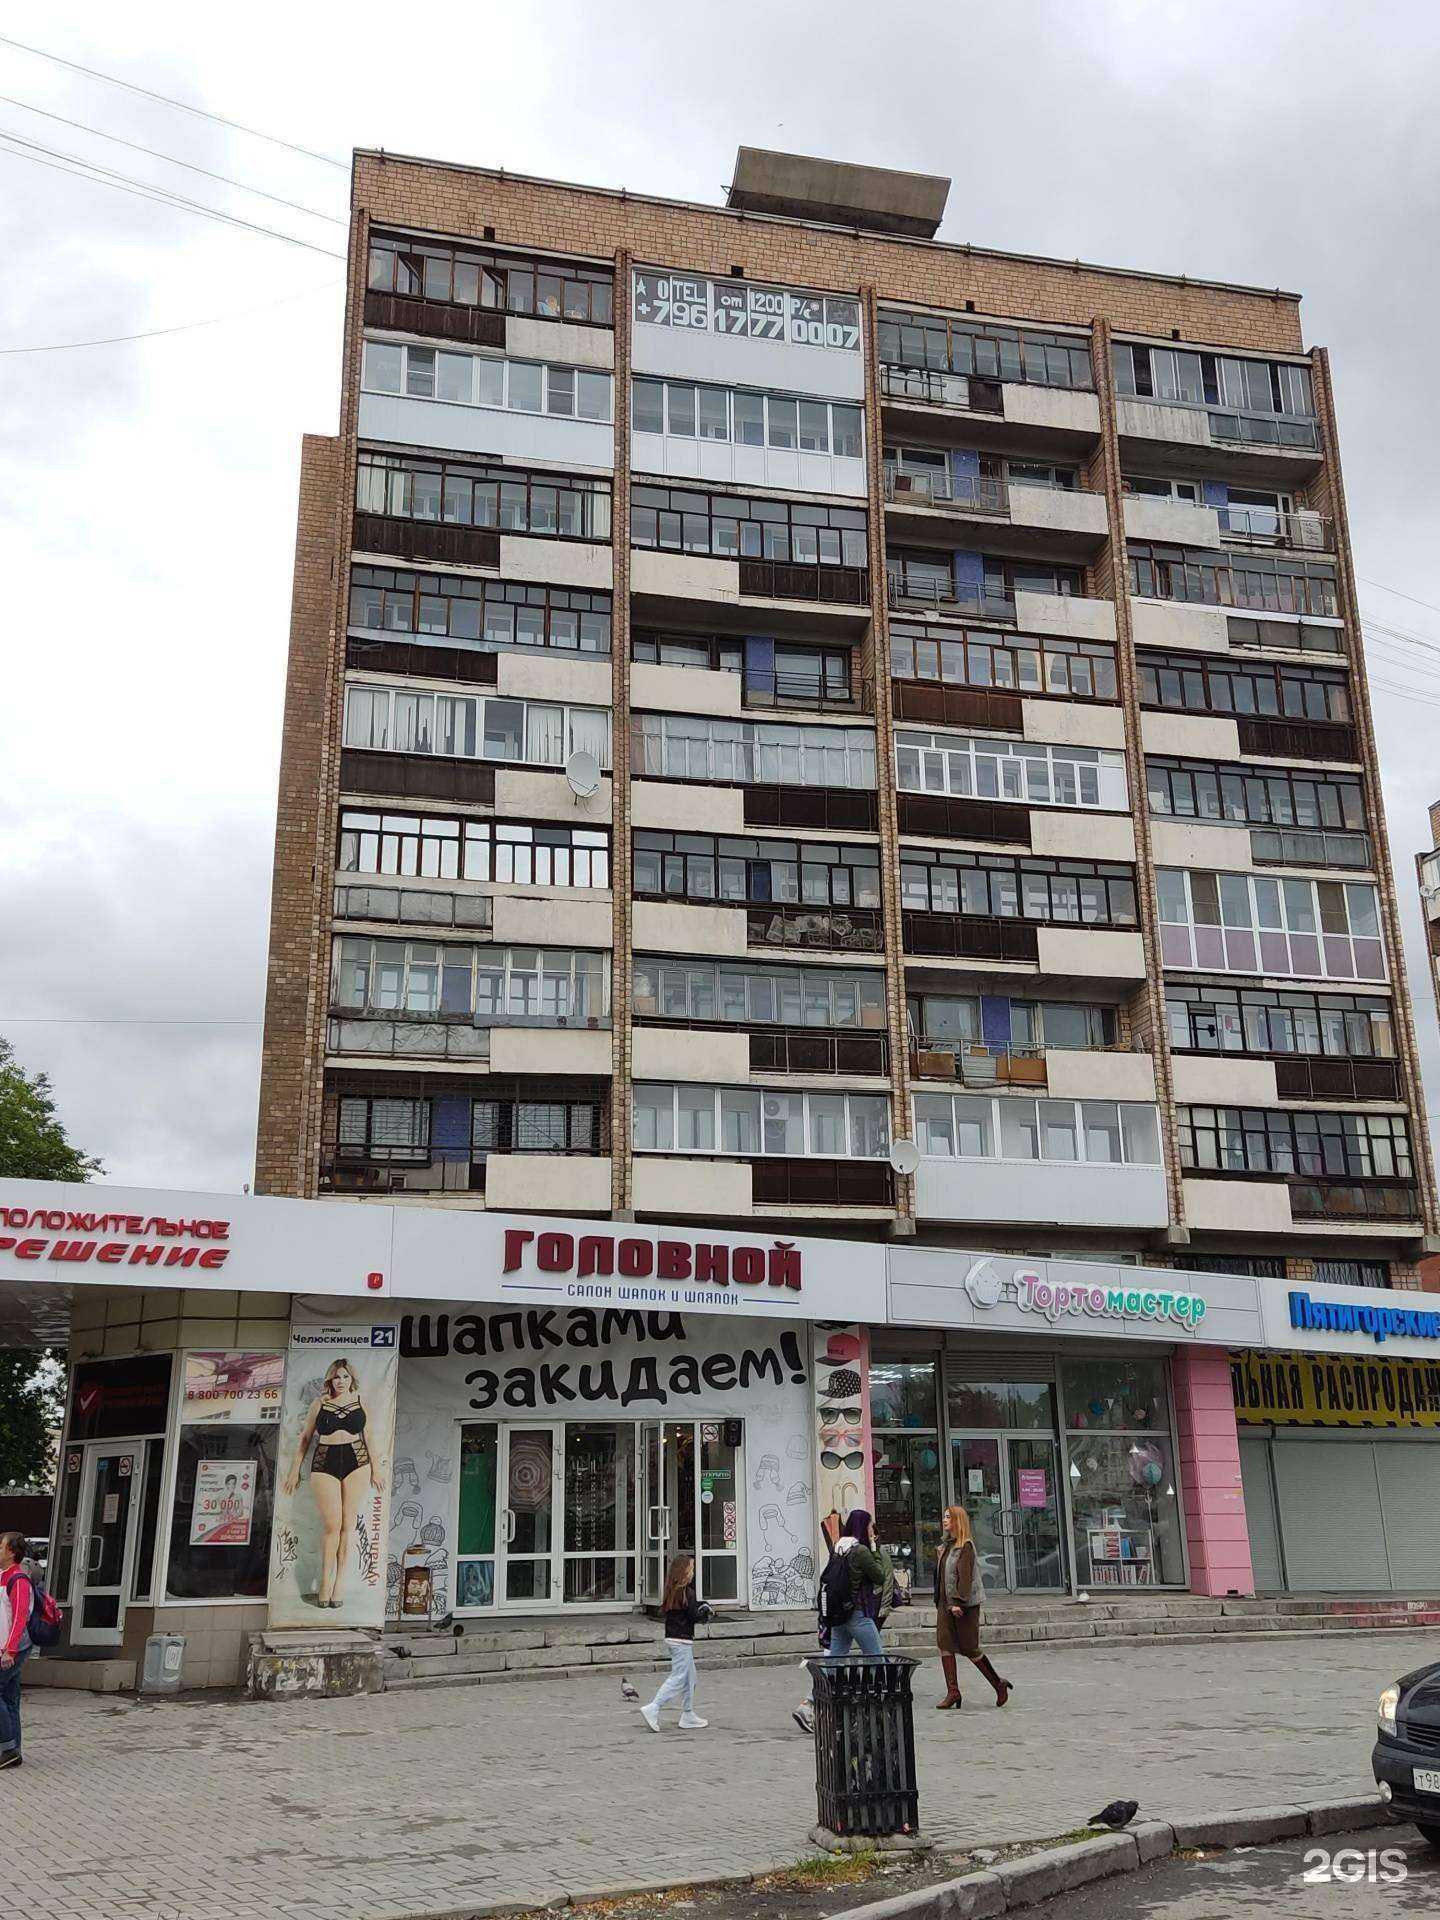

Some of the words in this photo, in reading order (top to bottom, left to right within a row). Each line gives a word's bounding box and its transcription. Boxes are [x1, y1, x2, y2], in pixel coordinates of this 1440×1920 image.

[502, 1229, 802, 1290] ГОЛОВНОЙ
[567, 1283, 612, 1299] САЛОН
[617, 1286, 666, 1301] ШАПОК
[671, 1290, 679, 1303] И
[684, 1291, 739, 1306] ШЛЯПОК
[1022, 1275, 1207, 1326] Тортомастер
[293, 1334, 370, 1345] Челюскинцев
[373, 1330, 394, 1344] 21
[464, 1331, 808, 1410] закидаем!
[198, 1391, 219, 1400] 800
[223, 1390, 243, 1400] 700
[247, 1390, 260, 1400] 23
[264, 1389, 278, 1399] 66
